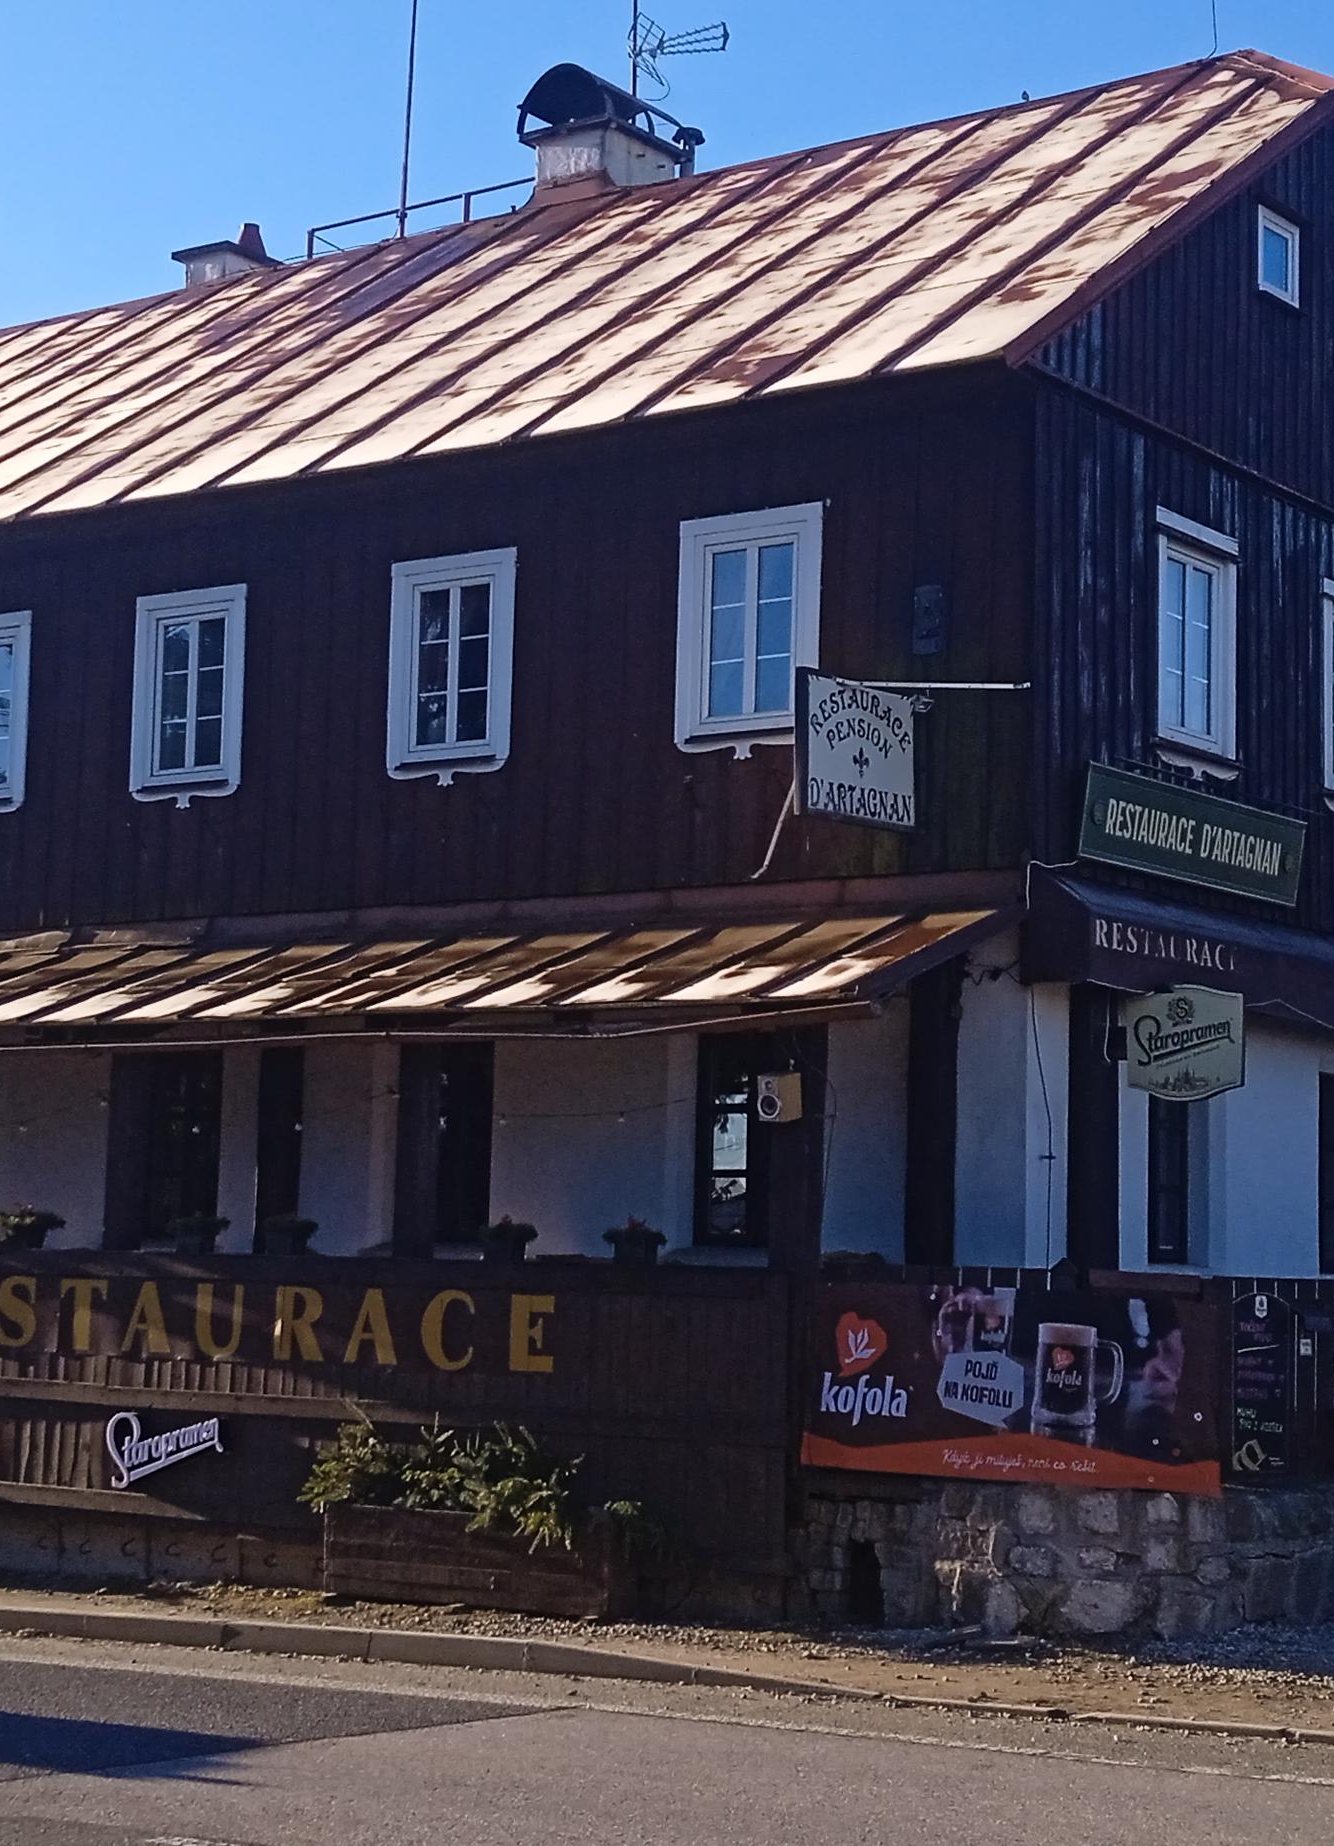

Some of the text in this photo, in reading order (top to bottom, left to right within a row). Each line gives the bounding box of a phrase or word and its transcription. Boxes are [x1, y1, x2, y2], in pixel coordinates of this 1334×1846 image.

[810, 687, 912, 754] RESTAURACE
[826, 717, 894, 759] PENSION
[810, 777, 912, 823] D'ARTAGNAN
[1105, 797, 1283, 877] RESTAURACE D'ARTAGNAN
[1133, 1014, 1235, 1067] Staropramen
[943, 1381, 1014, 1409] NA KOFOLU
[965, 1359, 999, 1380] POJĎ
[819, 1370, 909, 1427] kofola
[105, 1411, 226, 1490] Staropramen
